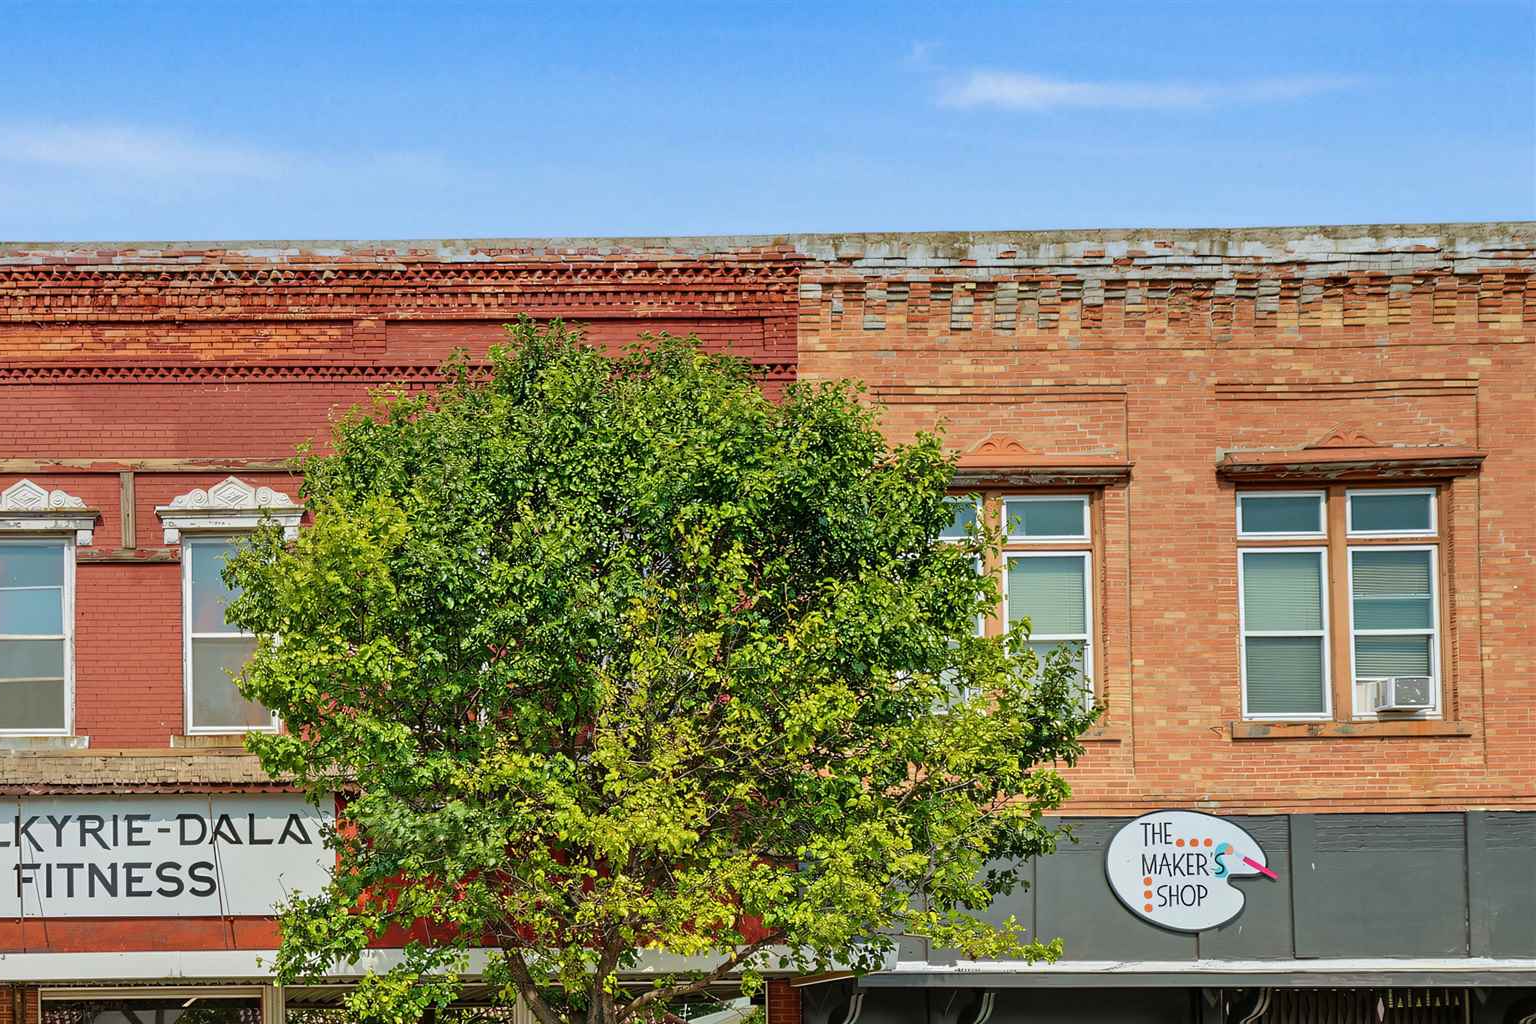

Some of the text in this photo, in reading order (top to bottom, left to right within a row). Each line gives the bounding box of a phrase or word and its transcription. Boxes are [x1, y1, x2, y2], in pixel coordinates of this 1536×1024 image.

[1140, 822, 1173, 847] THE
[1141, 852, 1226, 877] MAKER'S
[13, 861, 218, 899] FITNESS
[1156, 884, 1208, 907] SHOP
